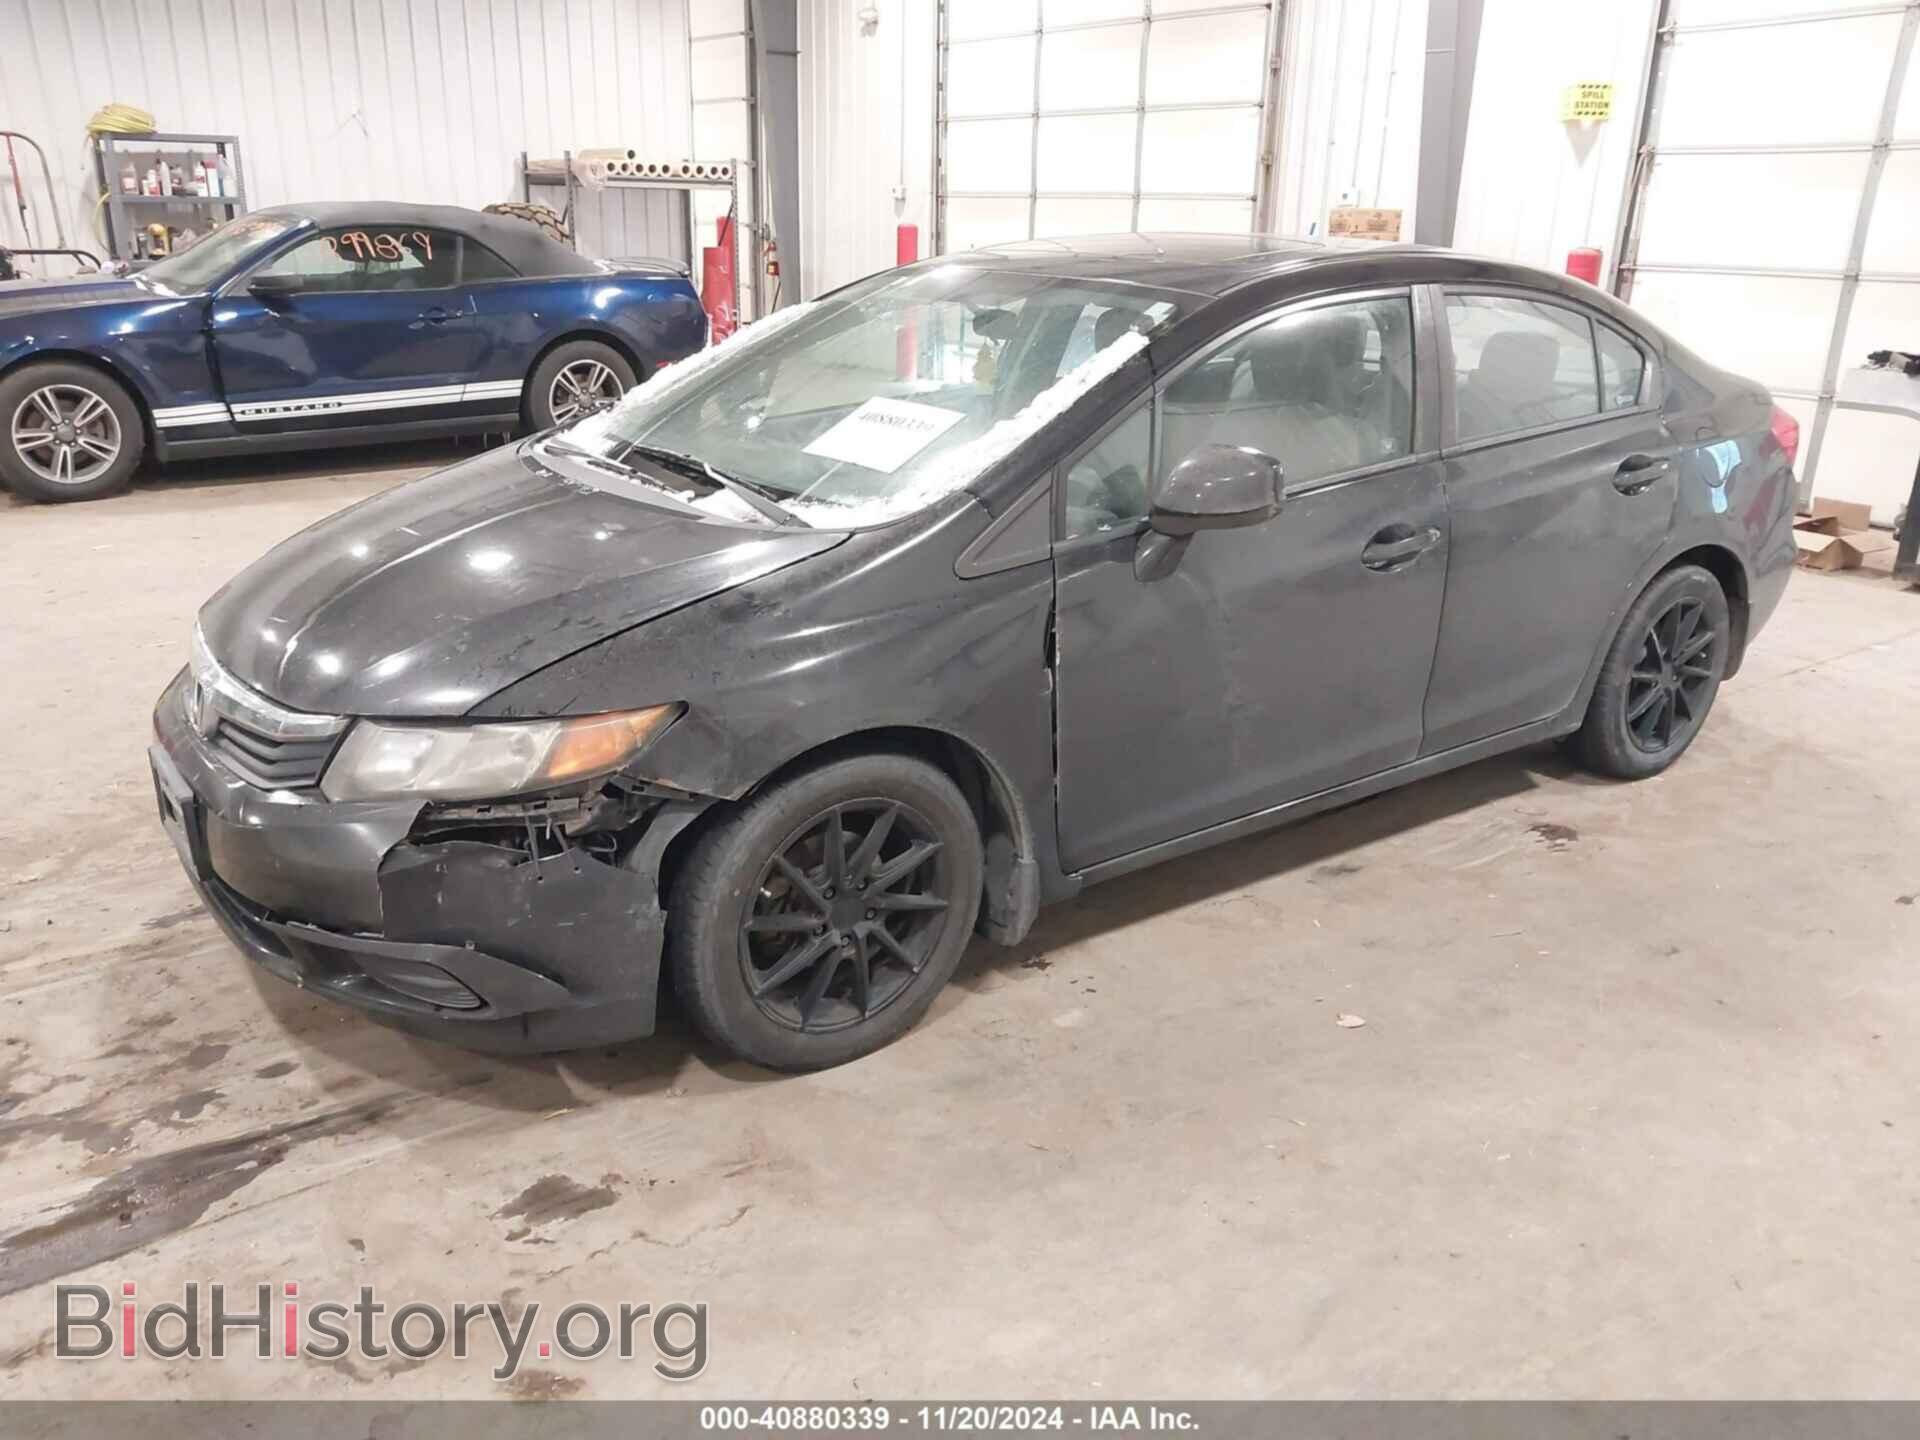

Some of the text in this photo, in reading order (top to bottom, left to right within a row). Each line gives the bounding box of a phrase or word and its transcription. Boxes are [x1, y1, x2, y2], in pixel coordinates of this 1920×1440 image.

[1582, 91, 1604, 99] SPILL
[1575, 101, 1609, 109] STATION
[243, 402, 339, 416] MUSTANG
